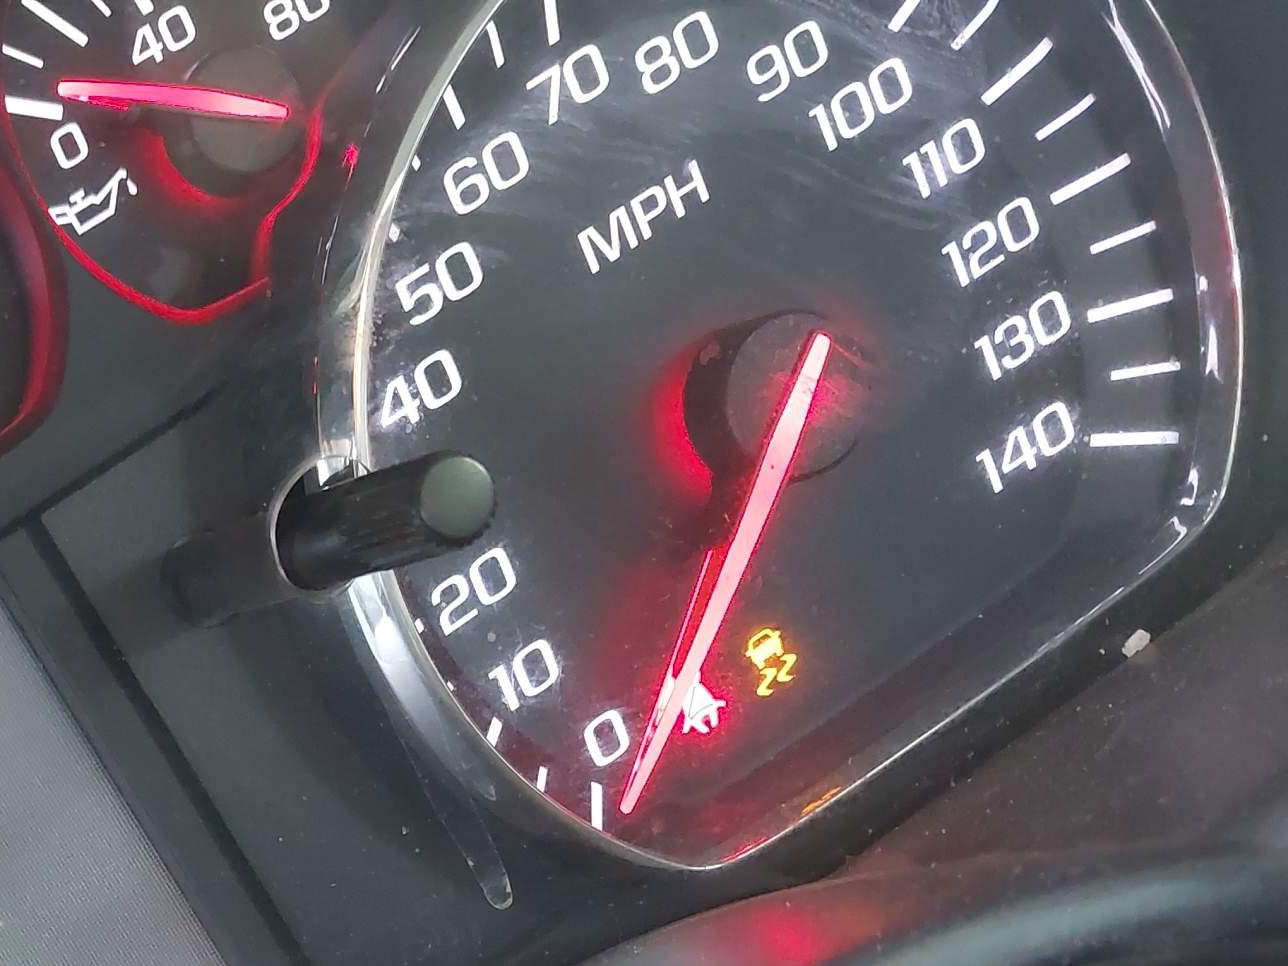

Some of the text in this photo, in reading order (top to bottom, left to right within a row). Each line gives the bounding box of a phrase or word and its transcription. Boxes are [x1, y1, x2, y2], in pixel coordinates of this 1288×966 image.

[131, 5, 196, 65] 40
[635, 10, 720, 95] 80
[746, 20, 830, 103] 90
[526, 44, 610, 125] 70
[808, 56, 913, 152] 100
[50, 122, 89, 169] 0
[443, 131, 530, 214] 60
[903, 117, 986, 198] 110
[576, 159, 712, 275] MPH
[942, 197, 1040, 287] 120
[395, 242, 483, 326] 50
[974, 290, 1072, 382] 130
[379, 349, 462, 428] 40
[976, 402, 1075, 494] 140
[431, 547, 518, 637] 20
[488, 639, 558, 711] 10
[583, 709, 630, 767] 0
